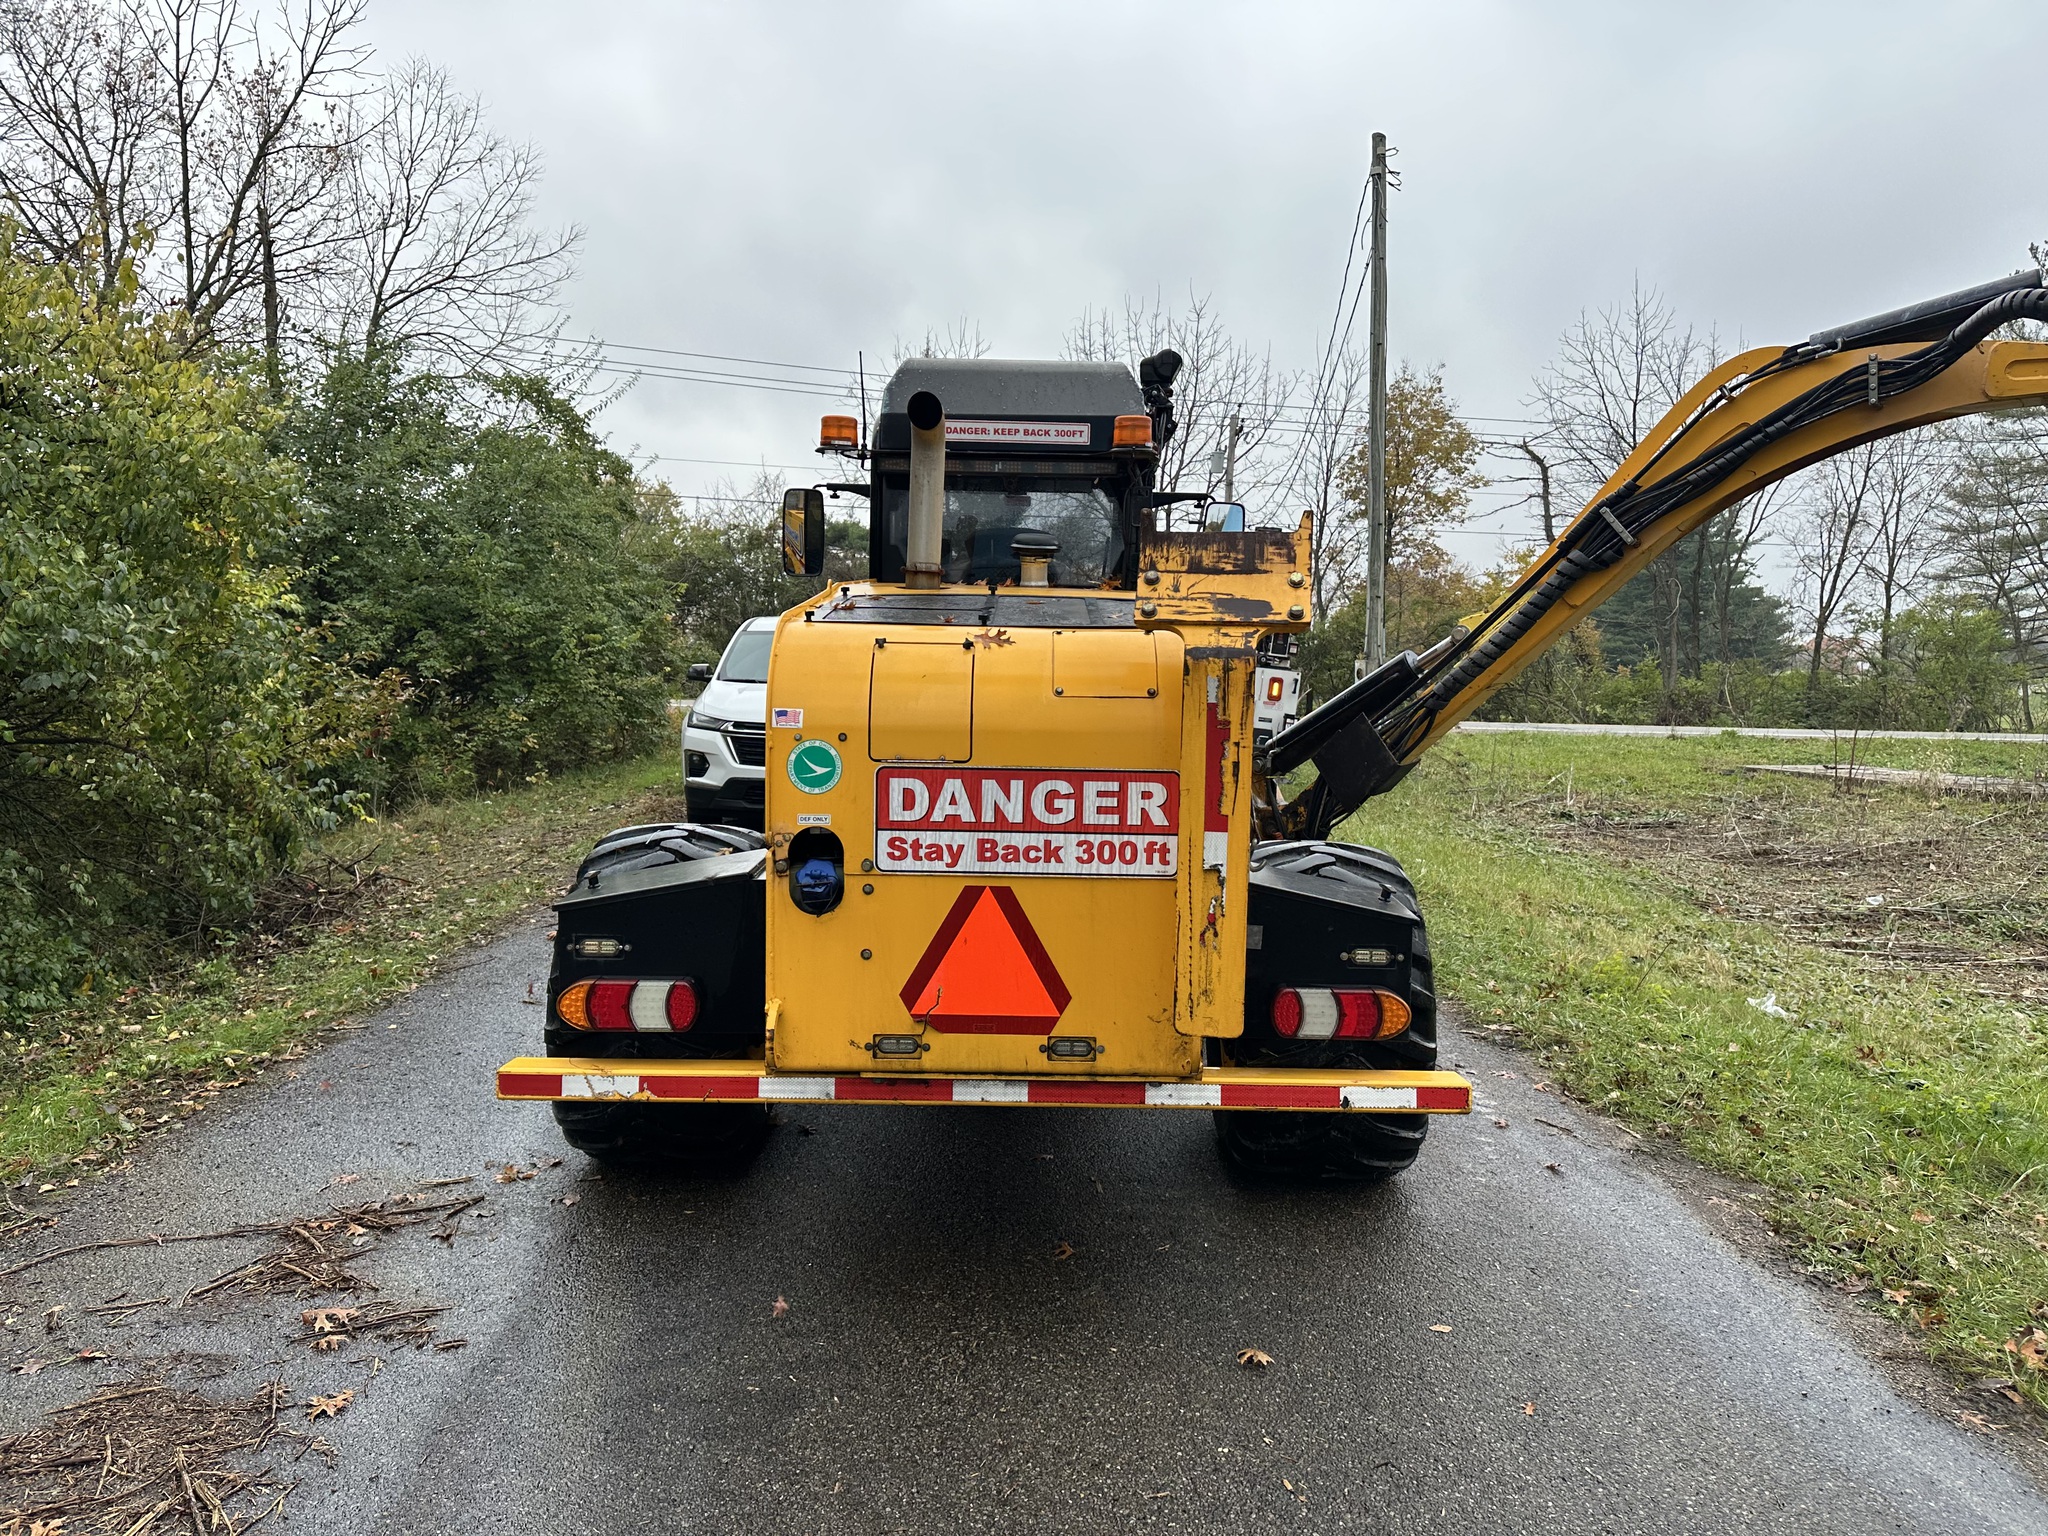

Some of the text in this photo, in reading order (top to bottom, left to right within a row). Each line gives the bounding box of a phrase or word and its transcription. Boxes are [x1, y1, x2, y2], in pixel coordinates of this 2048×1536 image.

[945, 426, 1085, 438] DANGER: KEEP BACK 300FT
[792, 743, 807, 756] STATE
[818, 741, 832, 751] OHIO
[788, 759, 807, 791] DEPARTMENT
[888, 777, 1170, 827] DANGER
[886, 836, 1170, 868] Stay Back 300 ft
